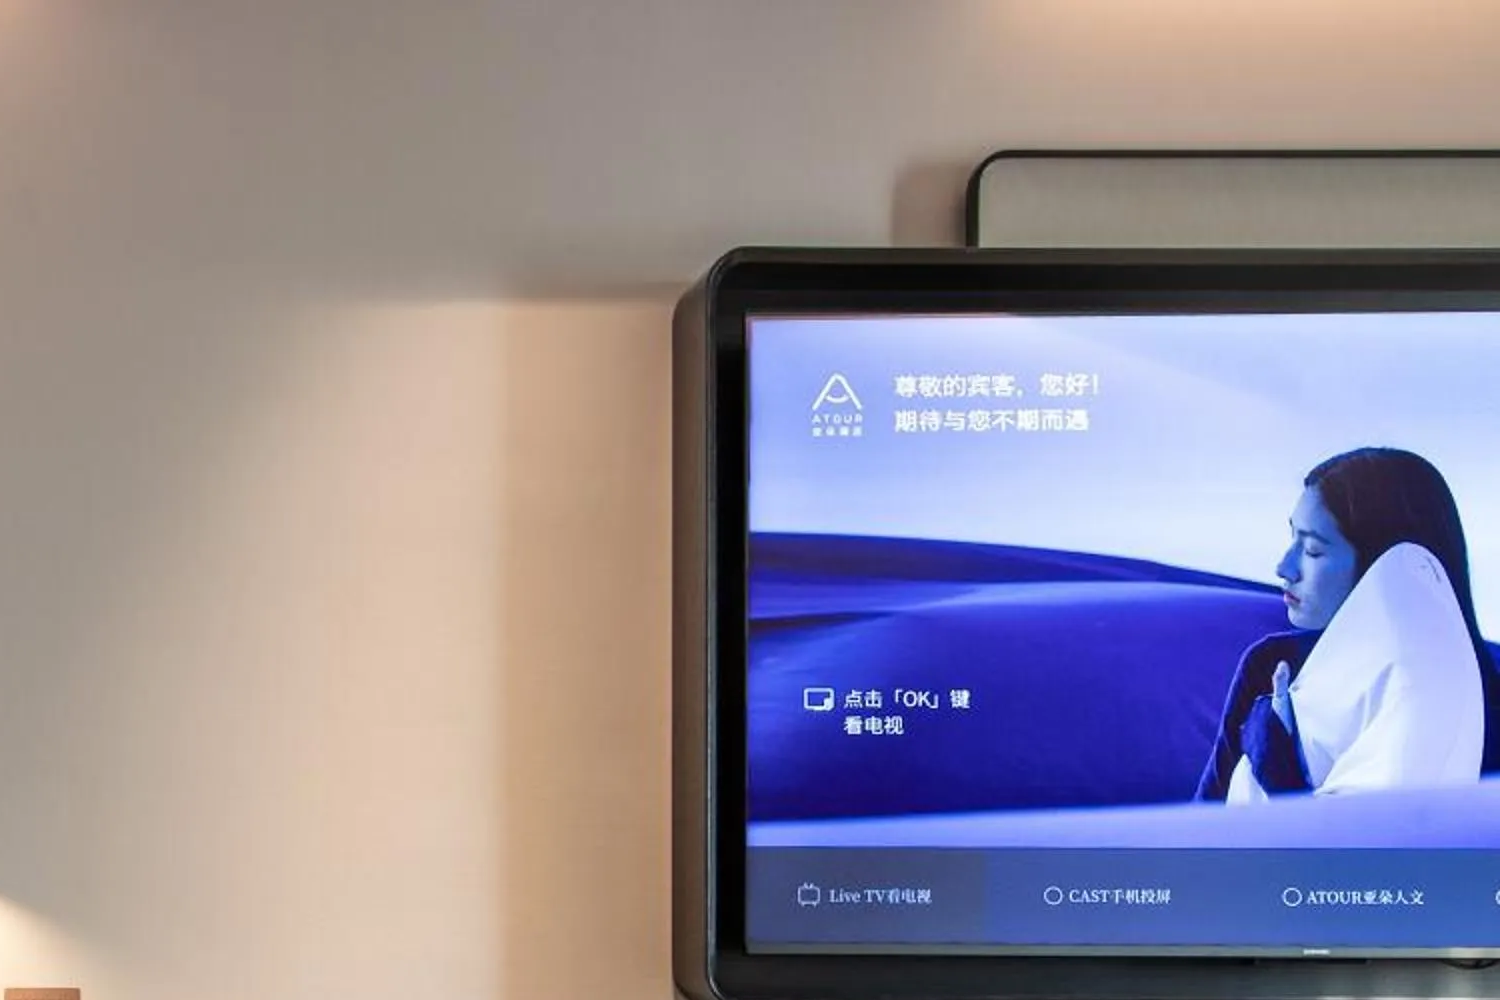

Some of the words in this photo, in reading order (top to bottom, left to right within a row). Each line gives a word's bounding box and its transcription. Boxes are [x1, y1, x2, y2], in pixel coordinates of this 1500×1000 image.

[811, 413, 863, 424] ATOUR
[894, 408, 1089, 432] 期待与您不期而遇
[843, 715, 904, 735] 看电视
[829, 888, 861, 903] Live
